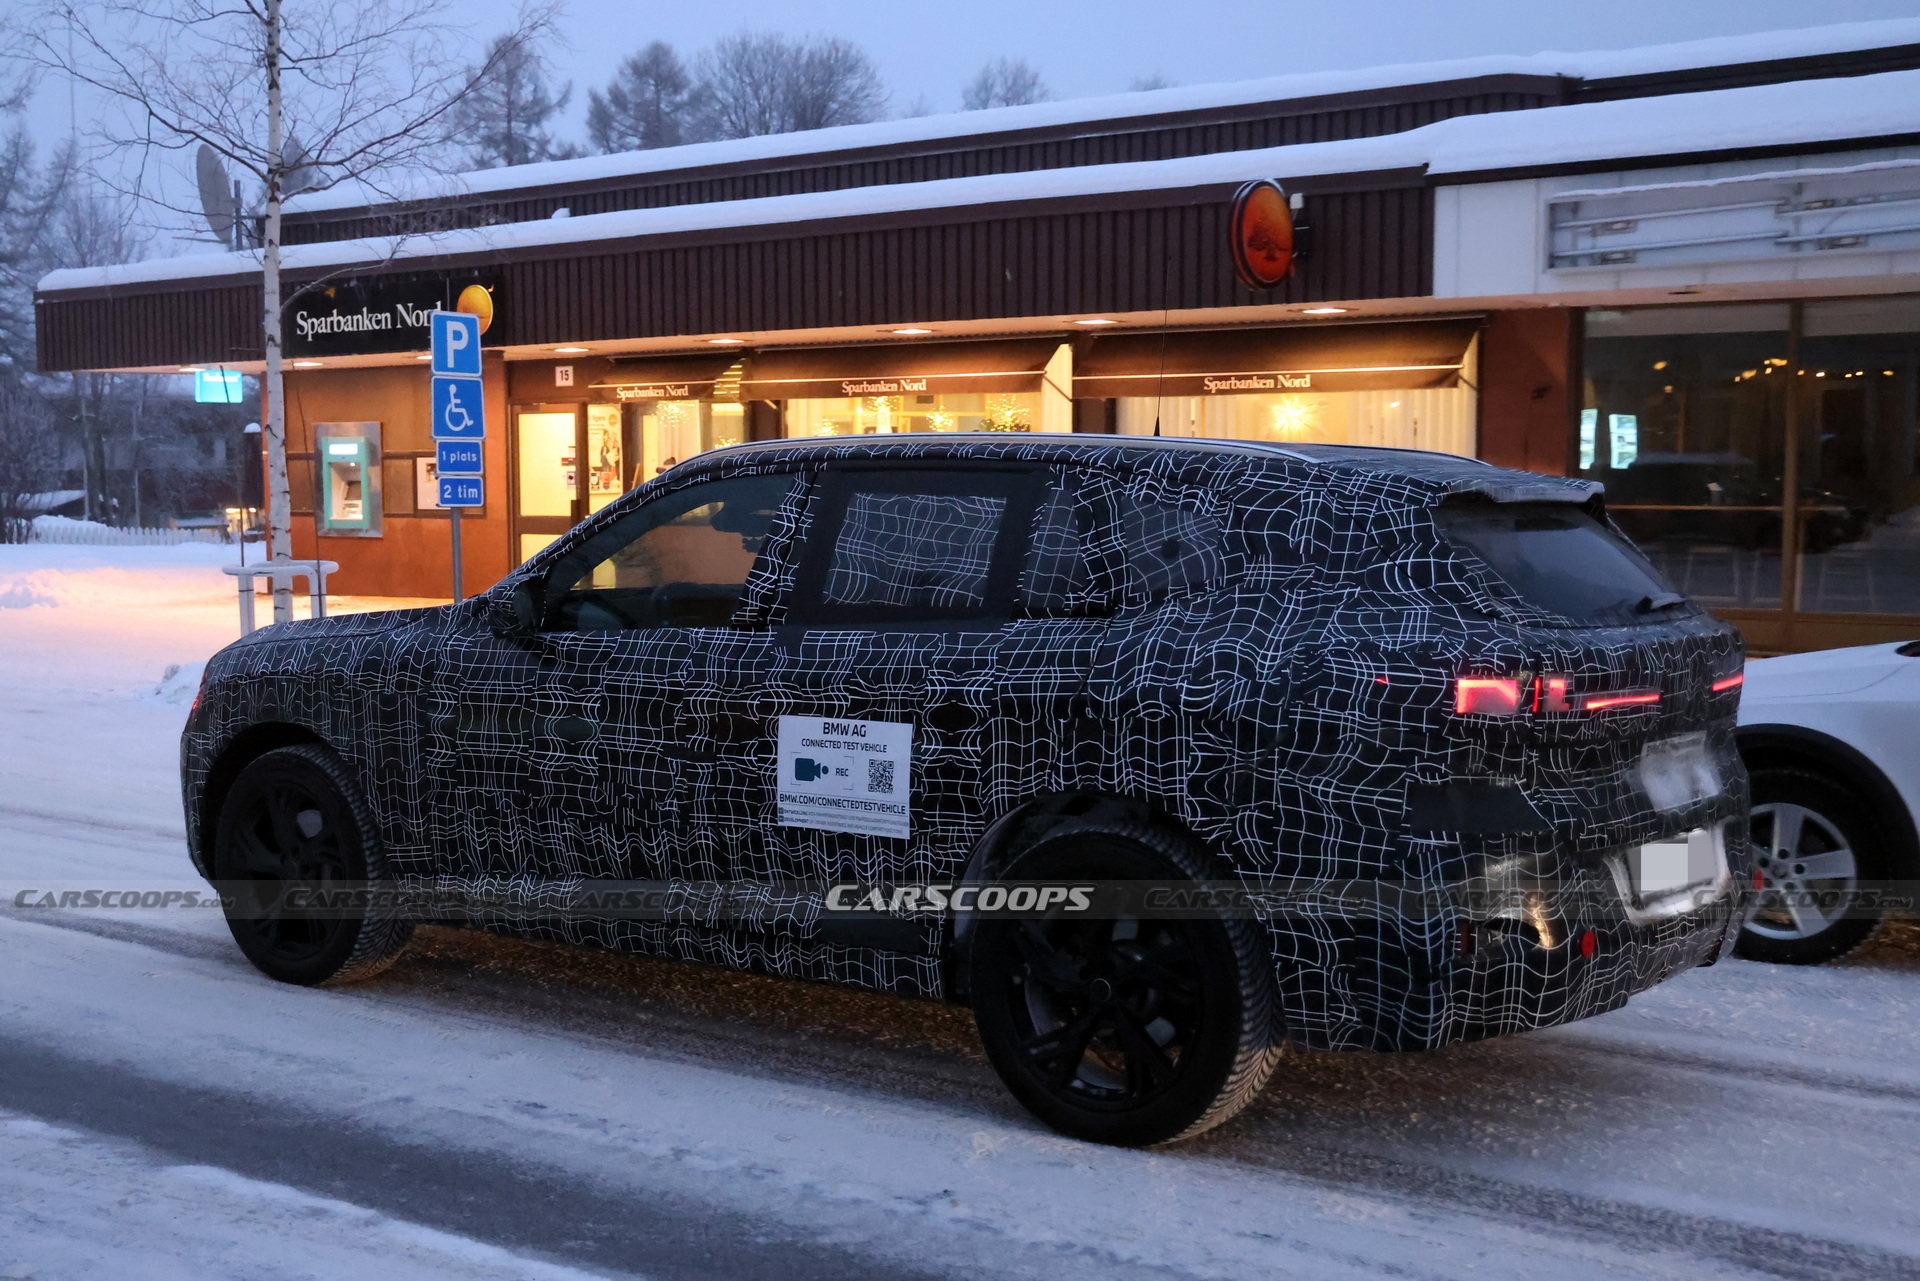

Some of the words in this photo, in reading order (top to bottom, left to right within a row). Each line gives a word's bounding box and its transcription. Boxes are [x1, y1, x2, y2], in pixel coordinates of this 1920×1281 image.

[297, 307, 392, 341] Sparbanken
[447, 320, 469, 368] P
[560, 370, 570, 381] 15
[1203, 376, 1275, 393] Sparbanken
[1277, 374, 1311, 388] Nord
[616, 387, 665, 401] Sparbanken
[666, 385, 689, 397] Nord
[841, 381, 898, 396] Sparbanken
[899, 379, 927, 392] Nord
[442, 451, 447, 461] 1
[450, 451, 477, 464] plats
[443, 484, 452, 499] 2
[457, 484, 478, 499] tim
[823, 721, 850, 736] BMW
[851, 724, 867, 738] AG
[801, 738, 842, 750] CONNECTED
[843, 741, 860, 751] TEST
[860, 743, 888, 753] VEHICLE
[835, 767, 849, 777] REC
[779, 793, 906, 815] BMW.COM/CONNECTEDTESTVEHICLE
